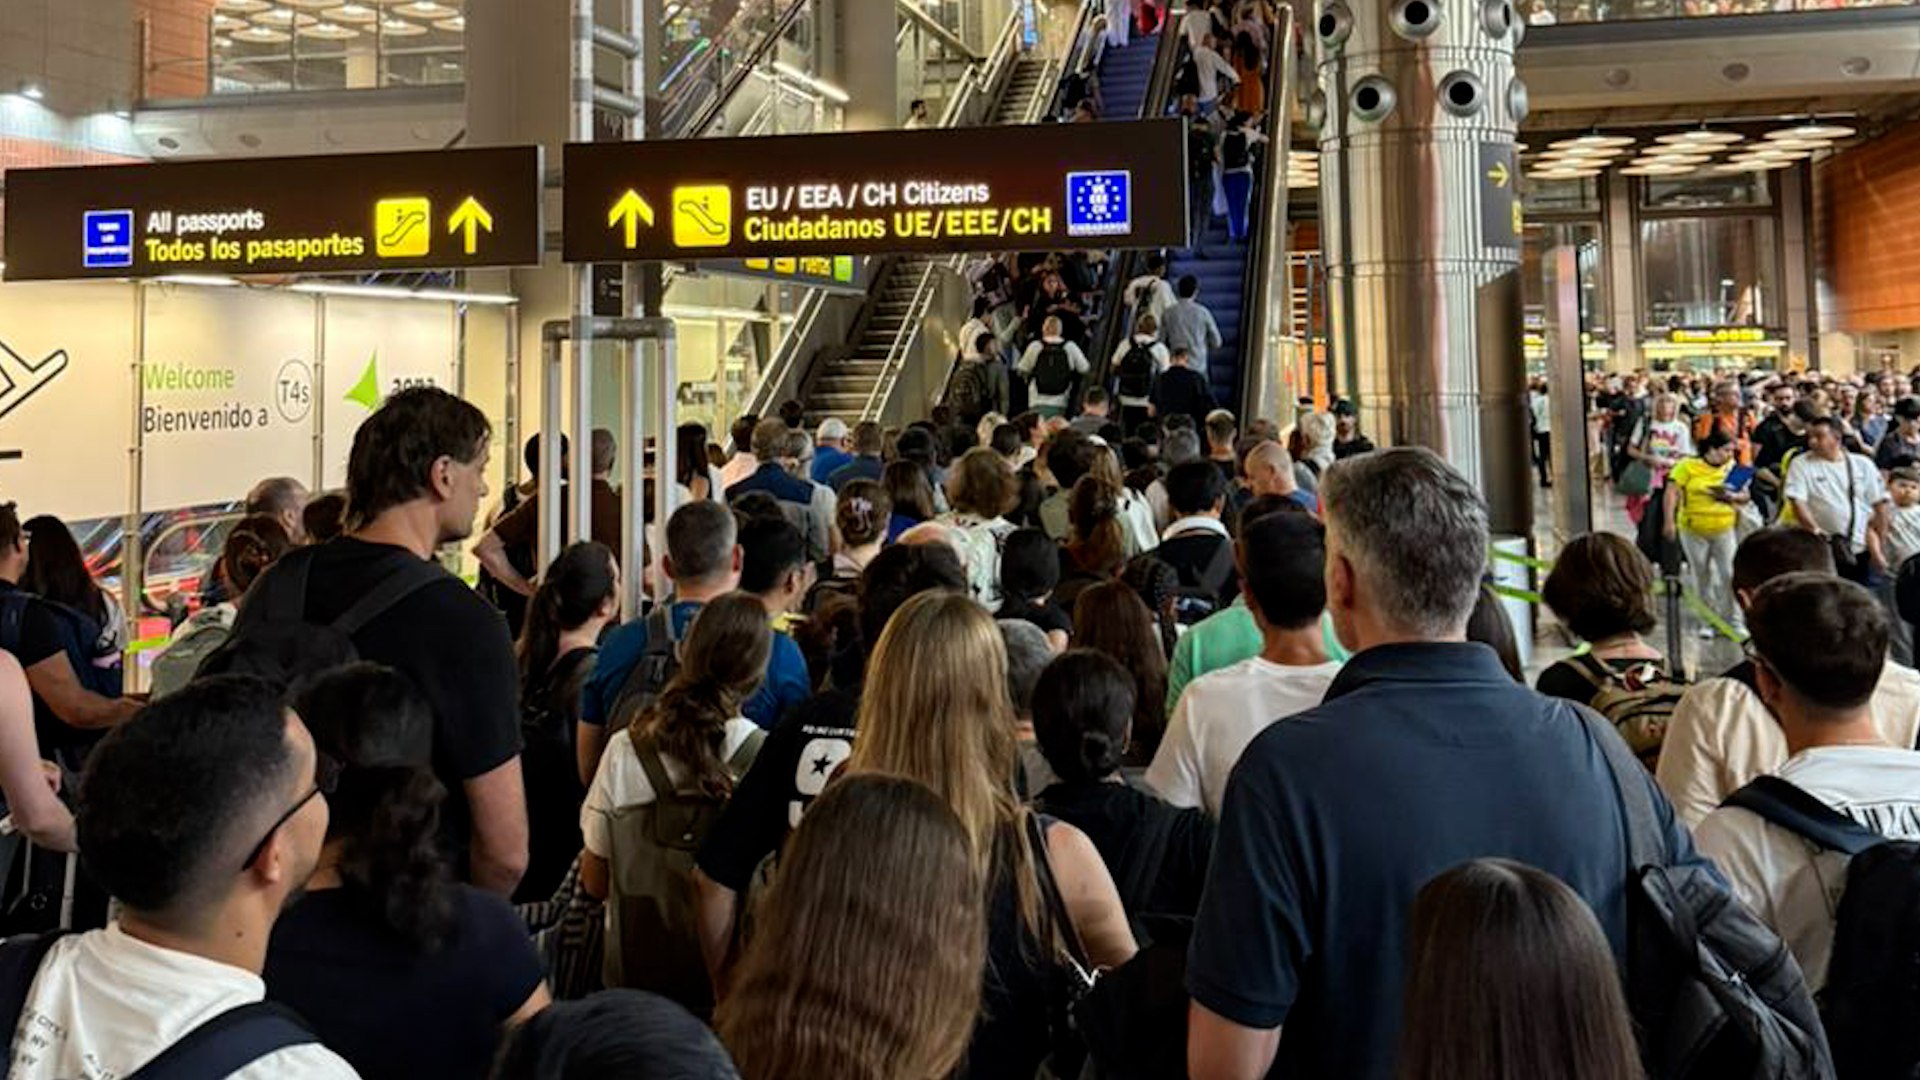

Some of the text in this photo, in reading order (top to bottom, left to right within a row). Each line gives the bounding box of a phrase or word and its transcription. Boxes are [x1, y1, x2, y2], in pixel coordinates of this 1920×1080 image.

[746, 180, 990, 212] EU / EEA / CH Citizens
[147, 209, 265, 236] All passports
[744, 206, 1052, 242] Ciudadanos UE/EEE/CH
[145, 232, 365, 264] Todos los pasaportes
[144, 363, 235, 390] Welcome
[279, 379, 310, 405] T4s
[143, 402, 269, 433] Bienvenido a
